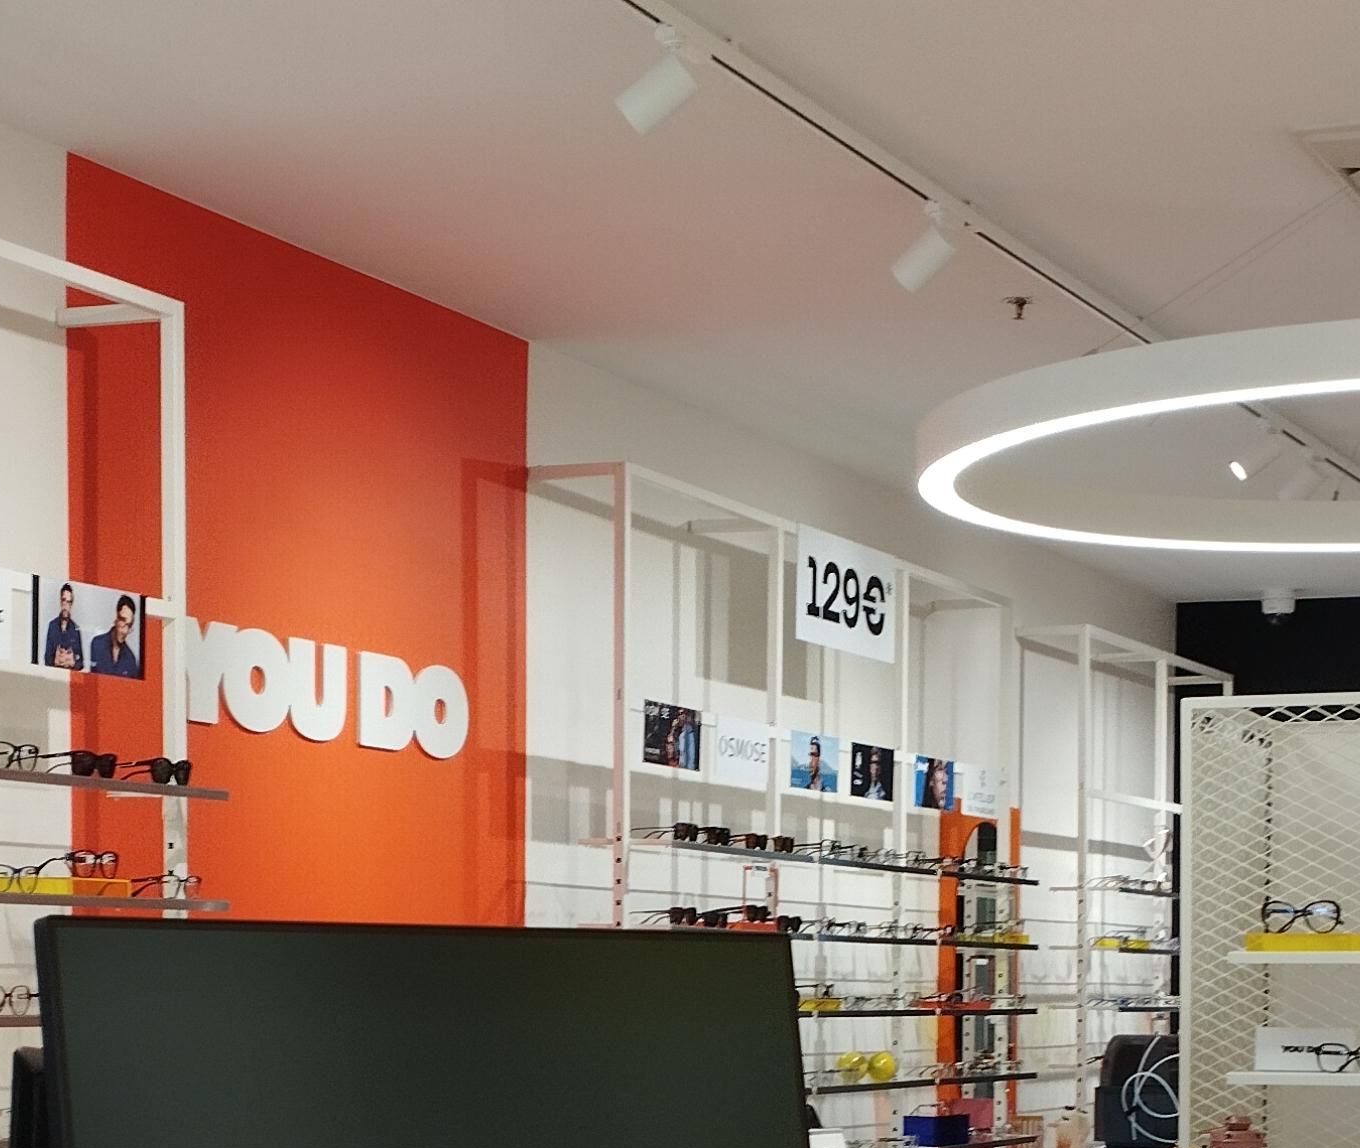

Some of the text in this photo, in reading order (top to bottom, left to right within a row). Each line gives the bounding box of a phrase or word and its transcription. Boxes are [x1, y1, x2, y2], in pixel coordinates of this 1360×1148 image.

[186, 615, 469, 759] YOU DO
[718, 735, 767, 764] OSMOSE
